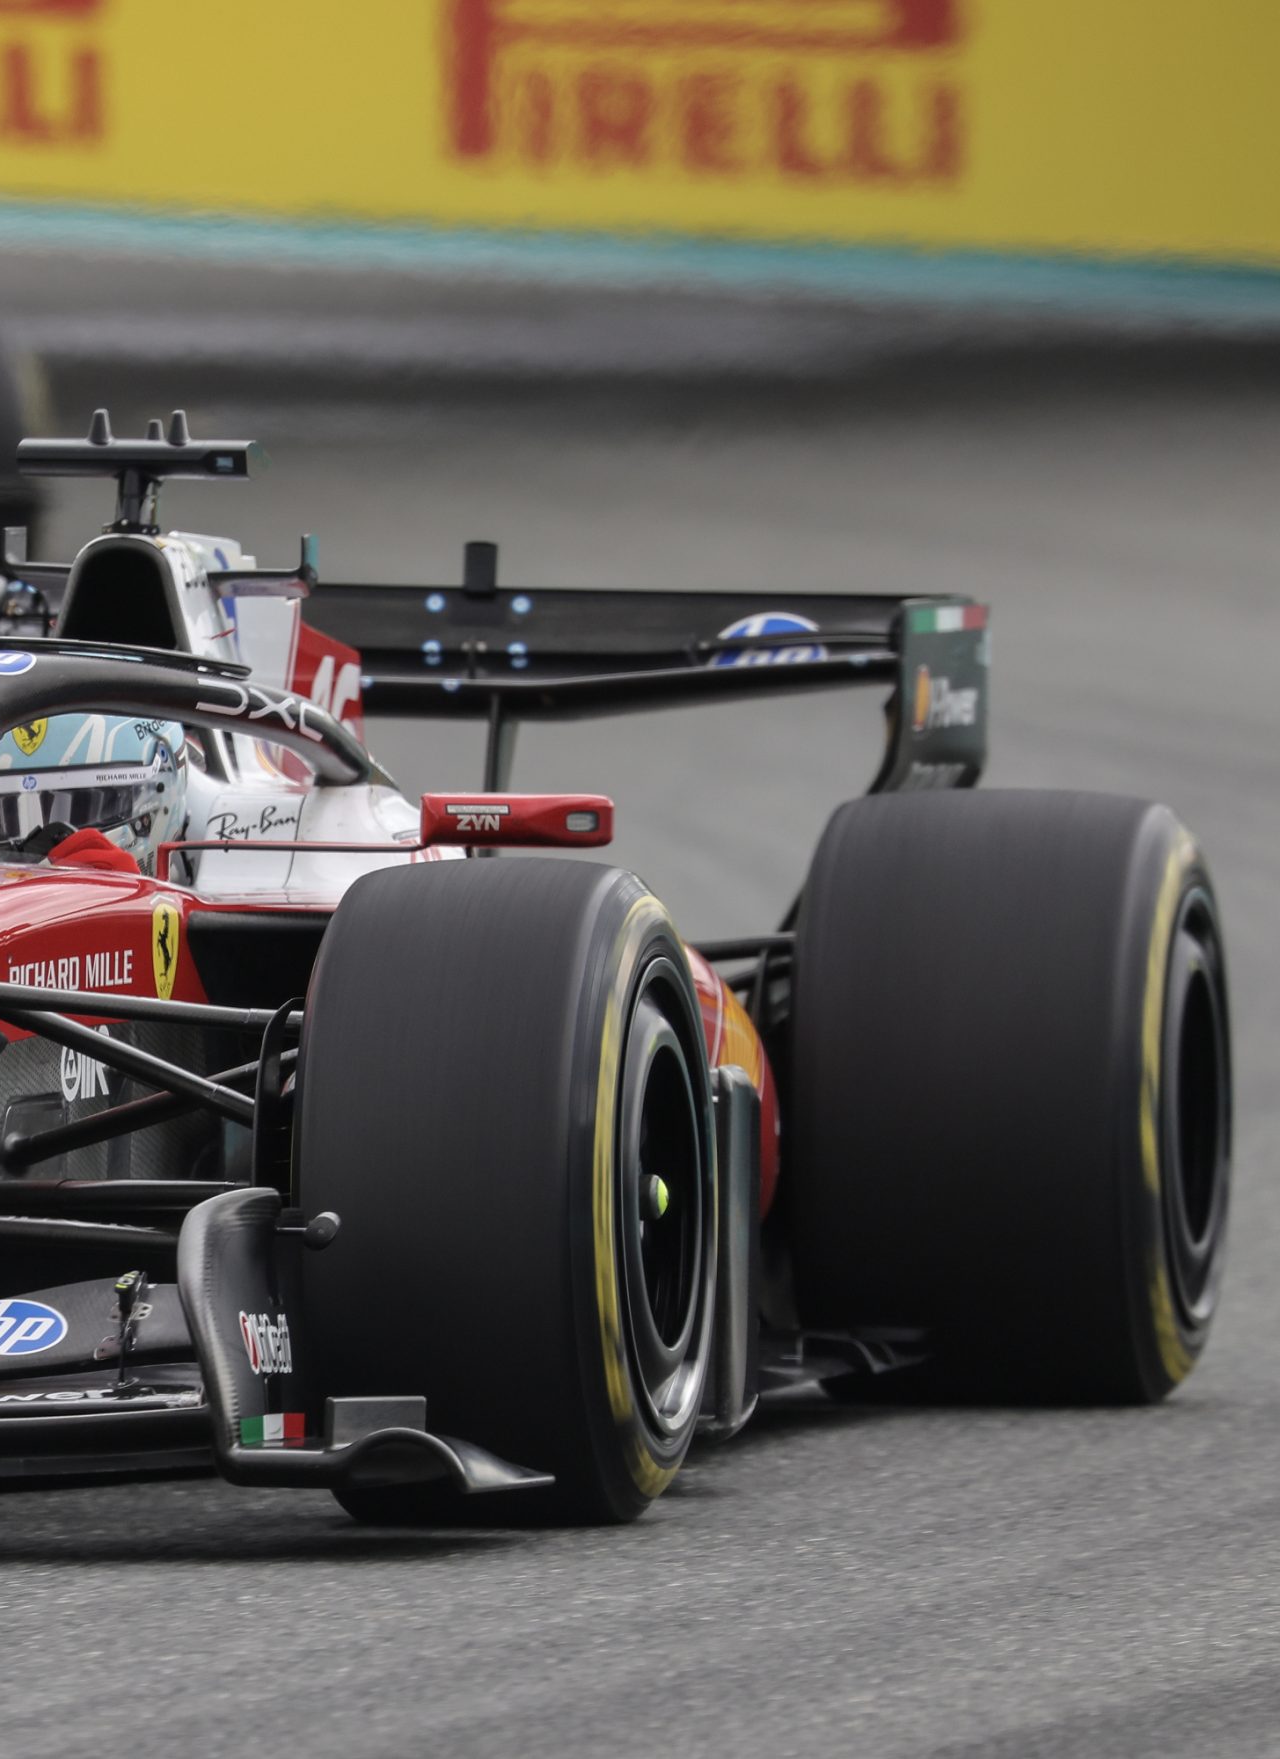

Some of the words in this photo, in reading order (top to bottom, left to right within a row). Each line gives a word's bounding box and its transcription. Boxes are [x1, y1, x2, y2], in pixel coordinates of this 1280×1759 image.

[195, 678, 324, 742] DXC
[95, 774, 128, 782] RICHARD
[206, 805, 297, 841] Ray-Ban
[456, 814, 501, 832] ZYN
[84, 949, 133, 989] MILLE
